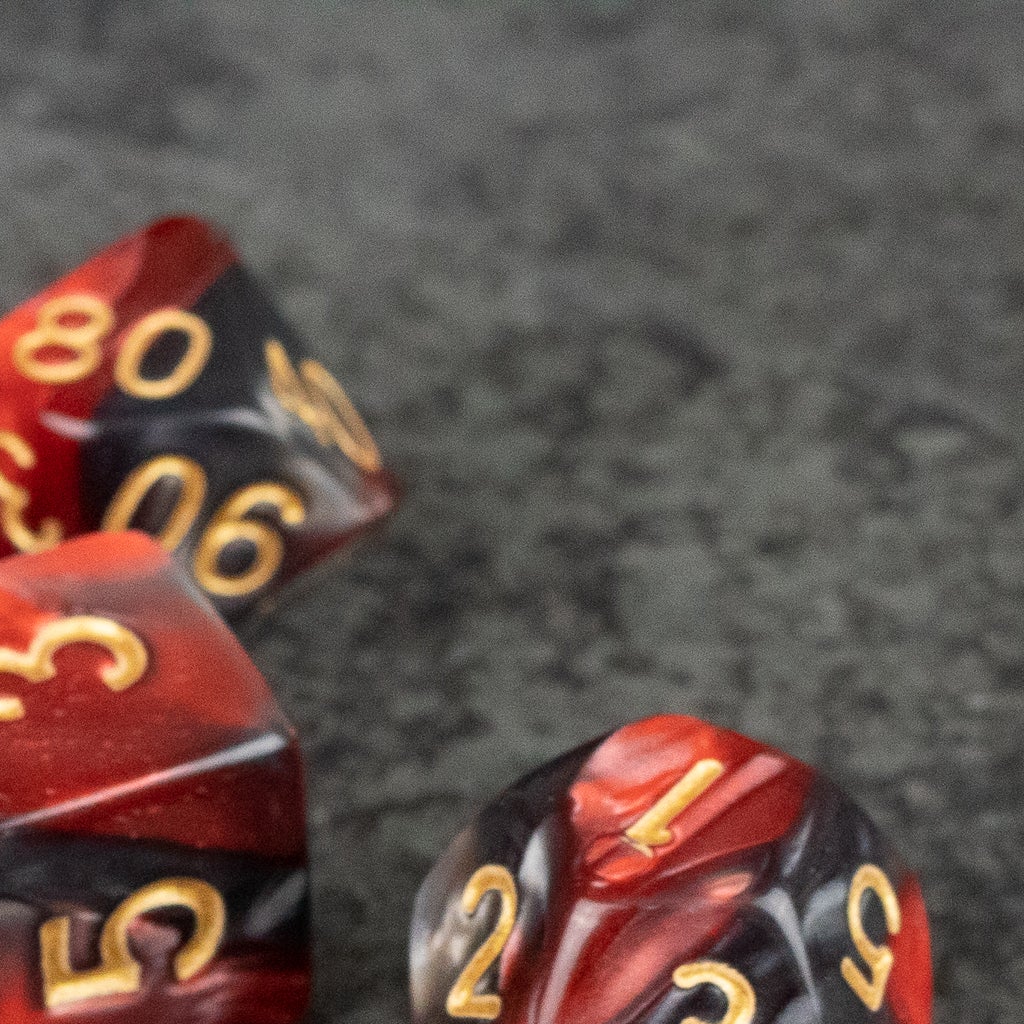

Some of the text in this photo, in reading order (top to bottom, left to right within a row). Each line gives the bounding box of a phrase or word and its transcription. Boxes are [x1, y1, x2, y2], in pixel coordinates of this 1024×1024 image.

[12, 294, 214, 400] 80
[622, 758, 725, 858] 1
[39, 876, 227, 1019] 5
[445, 863, 518, 1021] 2
[840, 862, 901, 1012] 5
